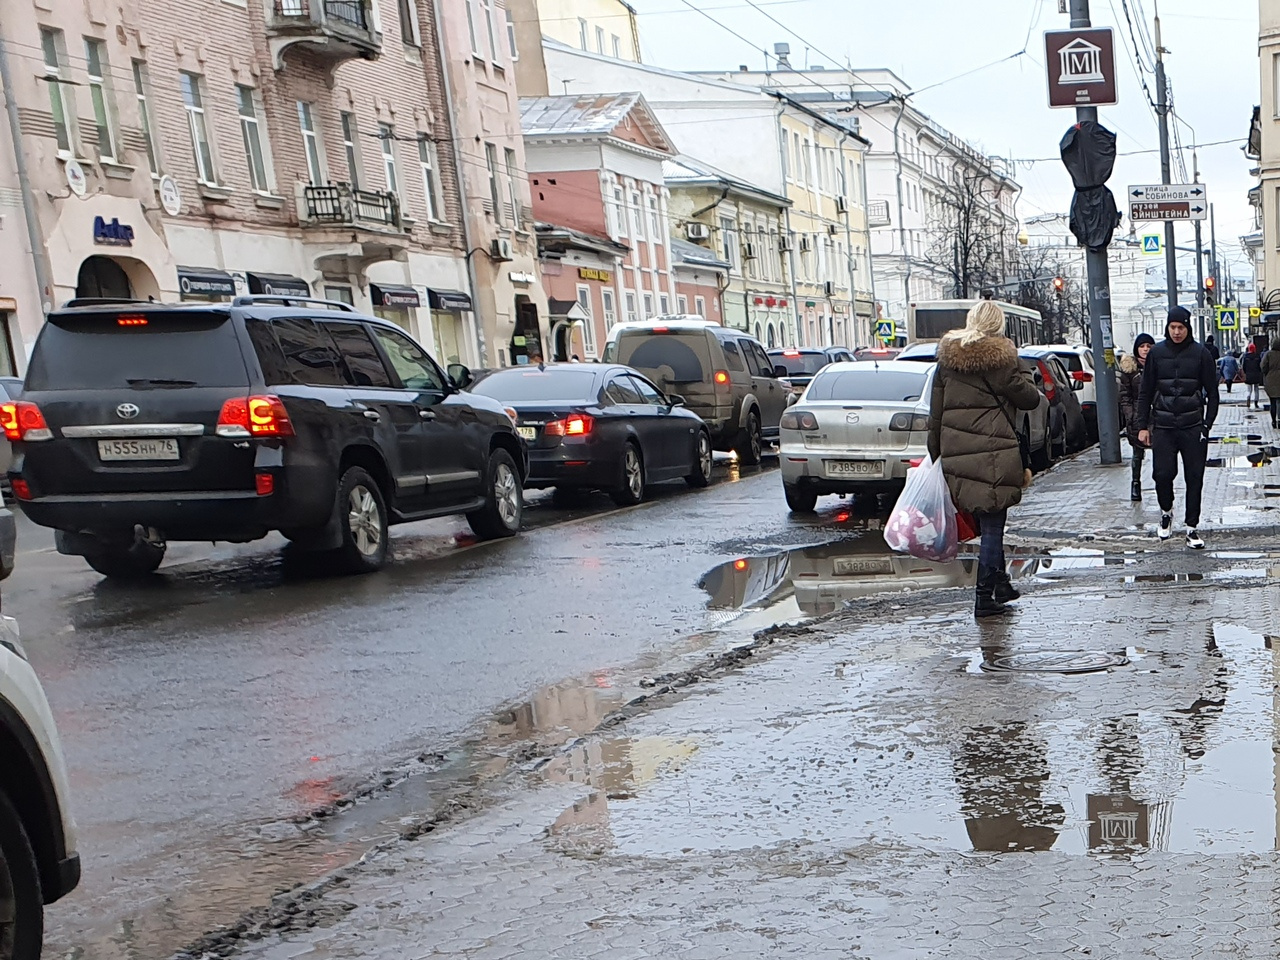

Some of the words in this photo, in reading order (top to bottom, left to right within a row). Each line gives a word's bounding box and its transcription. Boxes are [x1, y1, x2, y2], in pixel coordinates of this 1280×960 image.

[1145, 191, 1189, 200] СОБИНОВА
[1132, 203, 1159, 211] музей
[1132, 210, 1189, 219] ЭЙНШТЕЙНА
